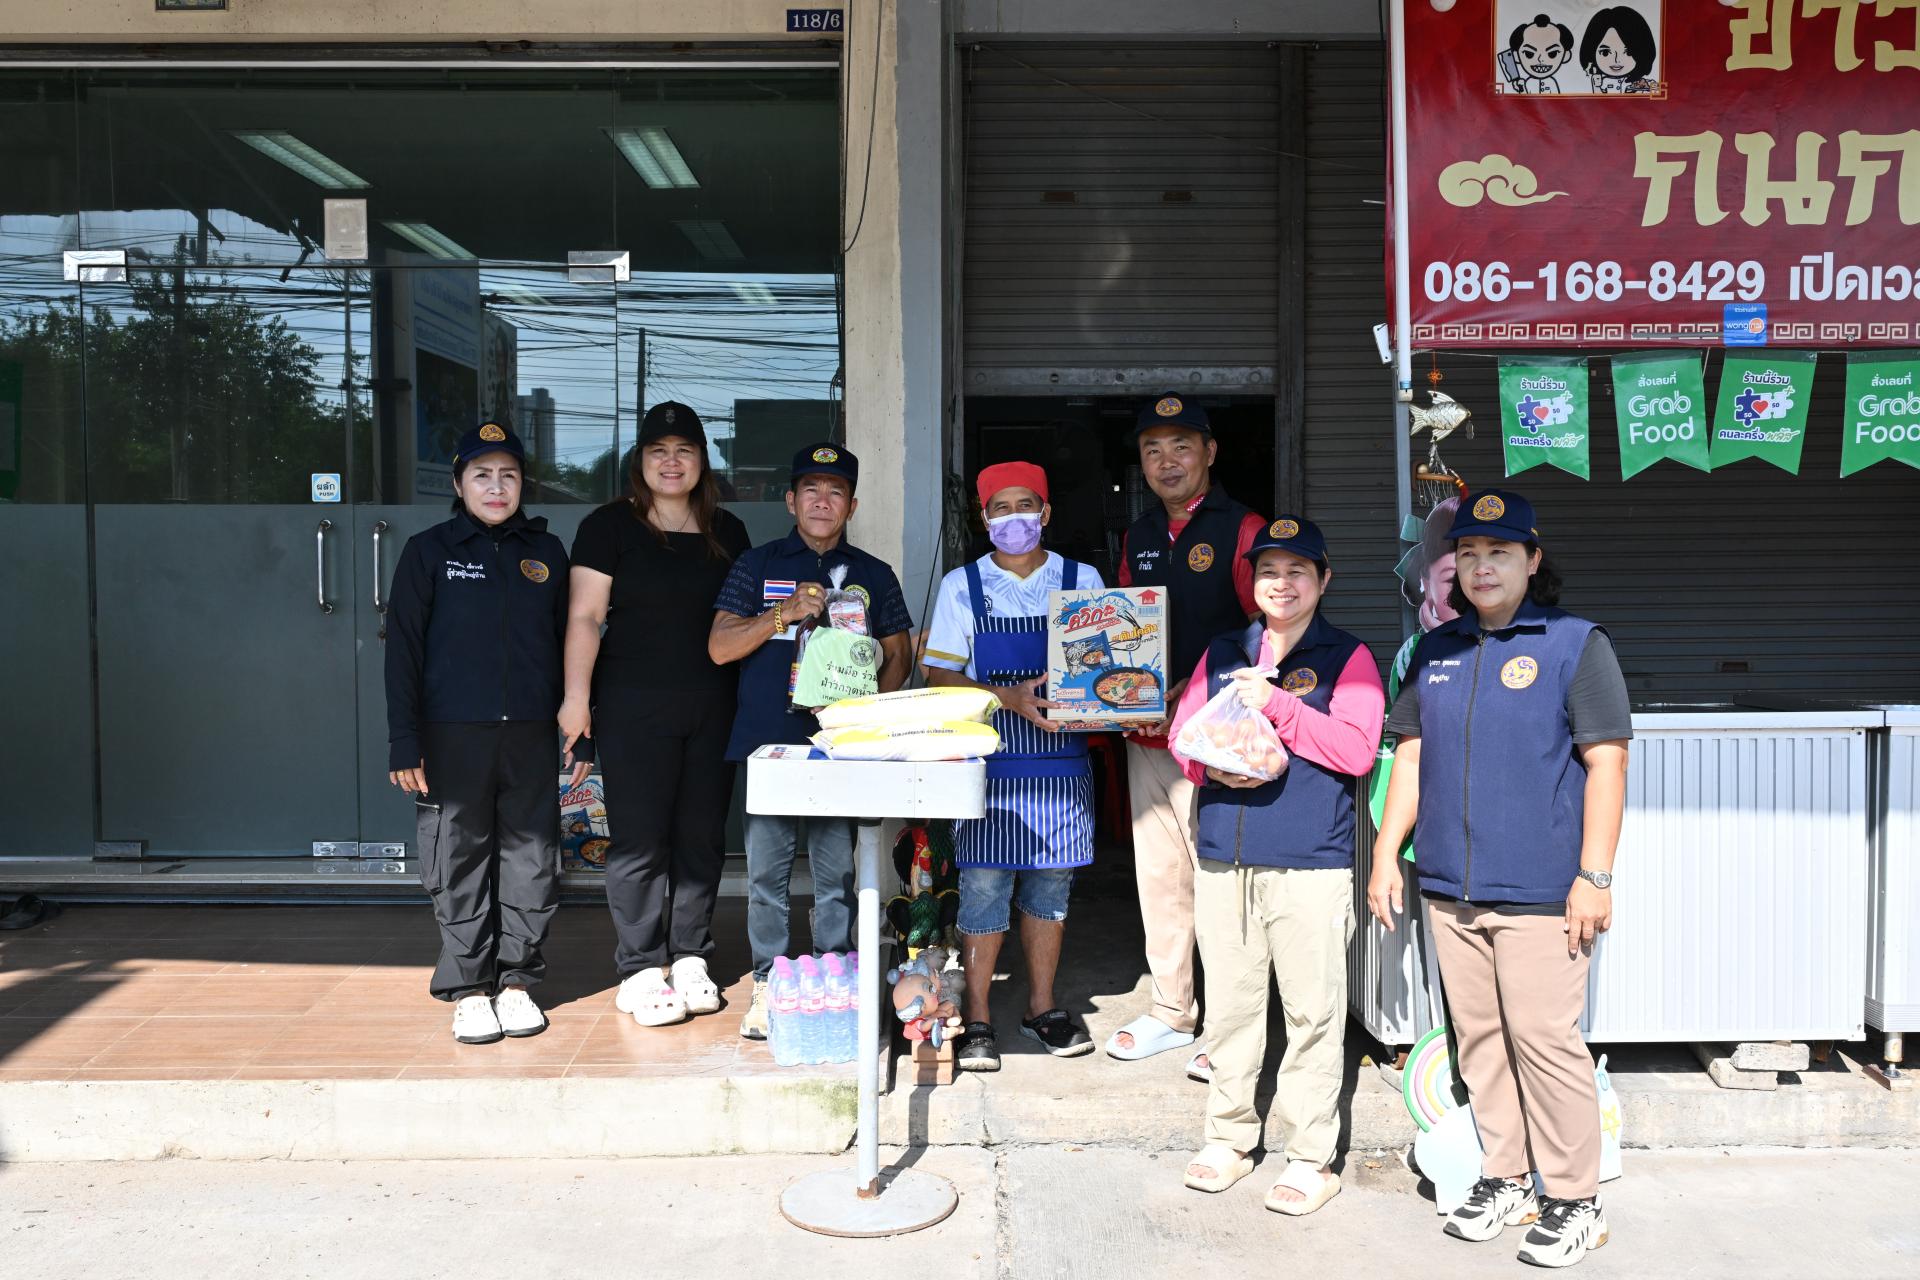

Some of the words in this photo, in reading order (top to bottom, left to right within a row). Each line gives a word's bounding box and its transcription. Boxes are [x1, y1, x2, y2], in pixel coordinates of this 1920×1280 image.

[793, 11, 840, 30] 118/6
[1424, 260, 1766, 302] 086-168-8429
[1789, 251, 1920, 301] เปิดเว
[1520, 375, 1567, 391] ร้านนี้ร่วม
[1638, 371, 1677, 388] สั่งเลยที่
[1743, 369, 1791, 385] ร้านนี้ร่วม
[1871, 371, 1912, 387] สั่งเลยที่
[1628, 390, 1692, 418] Grab
[1859, 391, 1920, 417] Grab
[1629, 416, 1694, 445] Food
[316, 481, 336, 491] ผลัก
